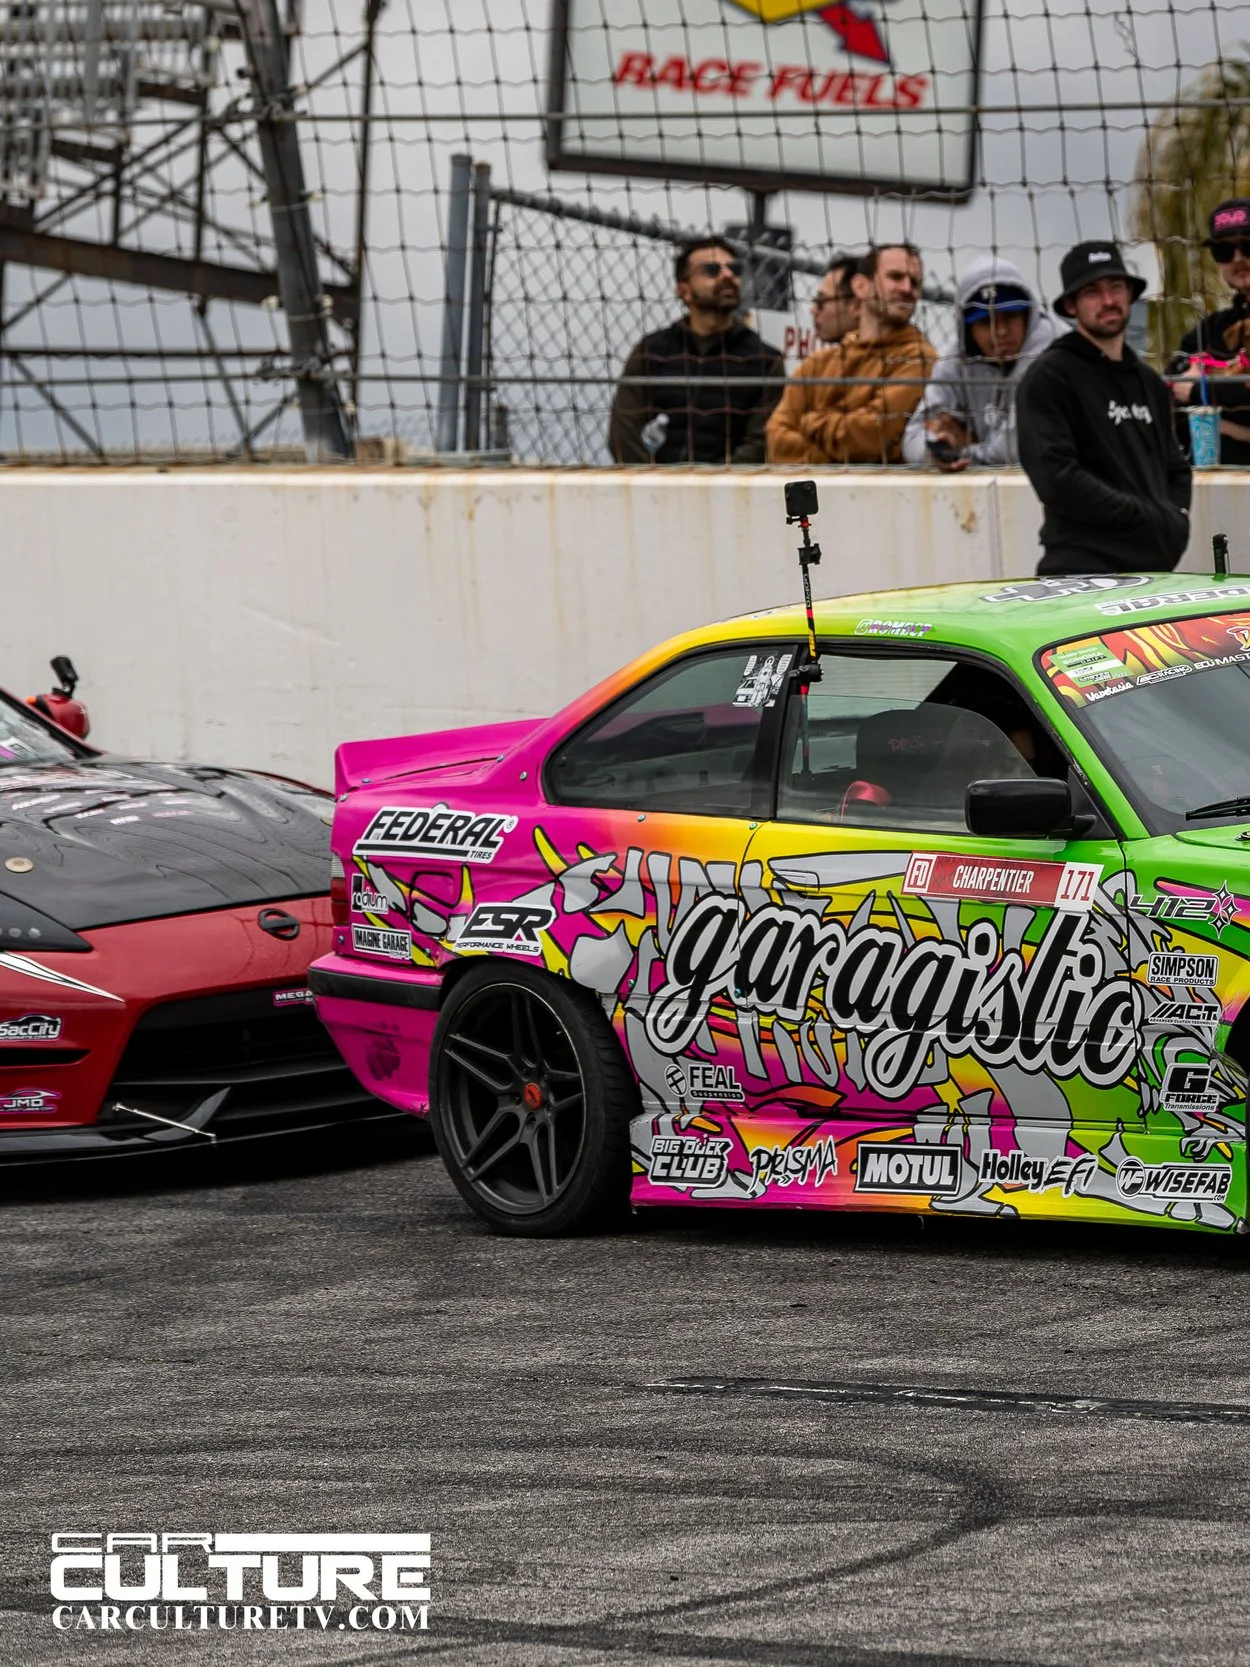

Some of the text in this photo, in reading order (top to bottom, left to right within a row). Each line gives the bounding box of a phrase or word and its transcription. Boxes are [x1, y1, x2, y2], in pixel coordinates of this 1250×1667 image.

[612, 51, 930, 110] RACE FUELS
[363, 810, 506, 849] FEDERAL
[469, 850, 493, 860] TIRES
[952, 864, 1035, 894] CHARPENTIER
[1060, 869, 1095, 902] 171
[1129, 894, 1217, 920] 412
[460, 906, 555, 943] ESR
[382, 933, 409, 952] GARAGE
[455, 942, 540, 953] PERFORMANCE WHEELS
[1151, 955, 1215, 979] SIMPSON
[275, 990, 313, 1001] MEGA
[647, 895, 1144, 1097] garagistic
[0, 1022, 61, 1038] SacCity
[689, 1066, 741, 1090] FEAL
[1164, 1093, 1218, 1103] FORCE
[1164, 1103, 1216, 1111] Transmissions
[652, 1139, 682, 1154] BIG
[652, 1155, 722, 1179] CLUB
[750, 1135, 838, 1190] PRISMA
[862, 1153, 954, 1186] MOTUL
[980, 1150, 1097, 1196] Holley EFI
[1146, 1168, 1231, 1194] WISEFAB
